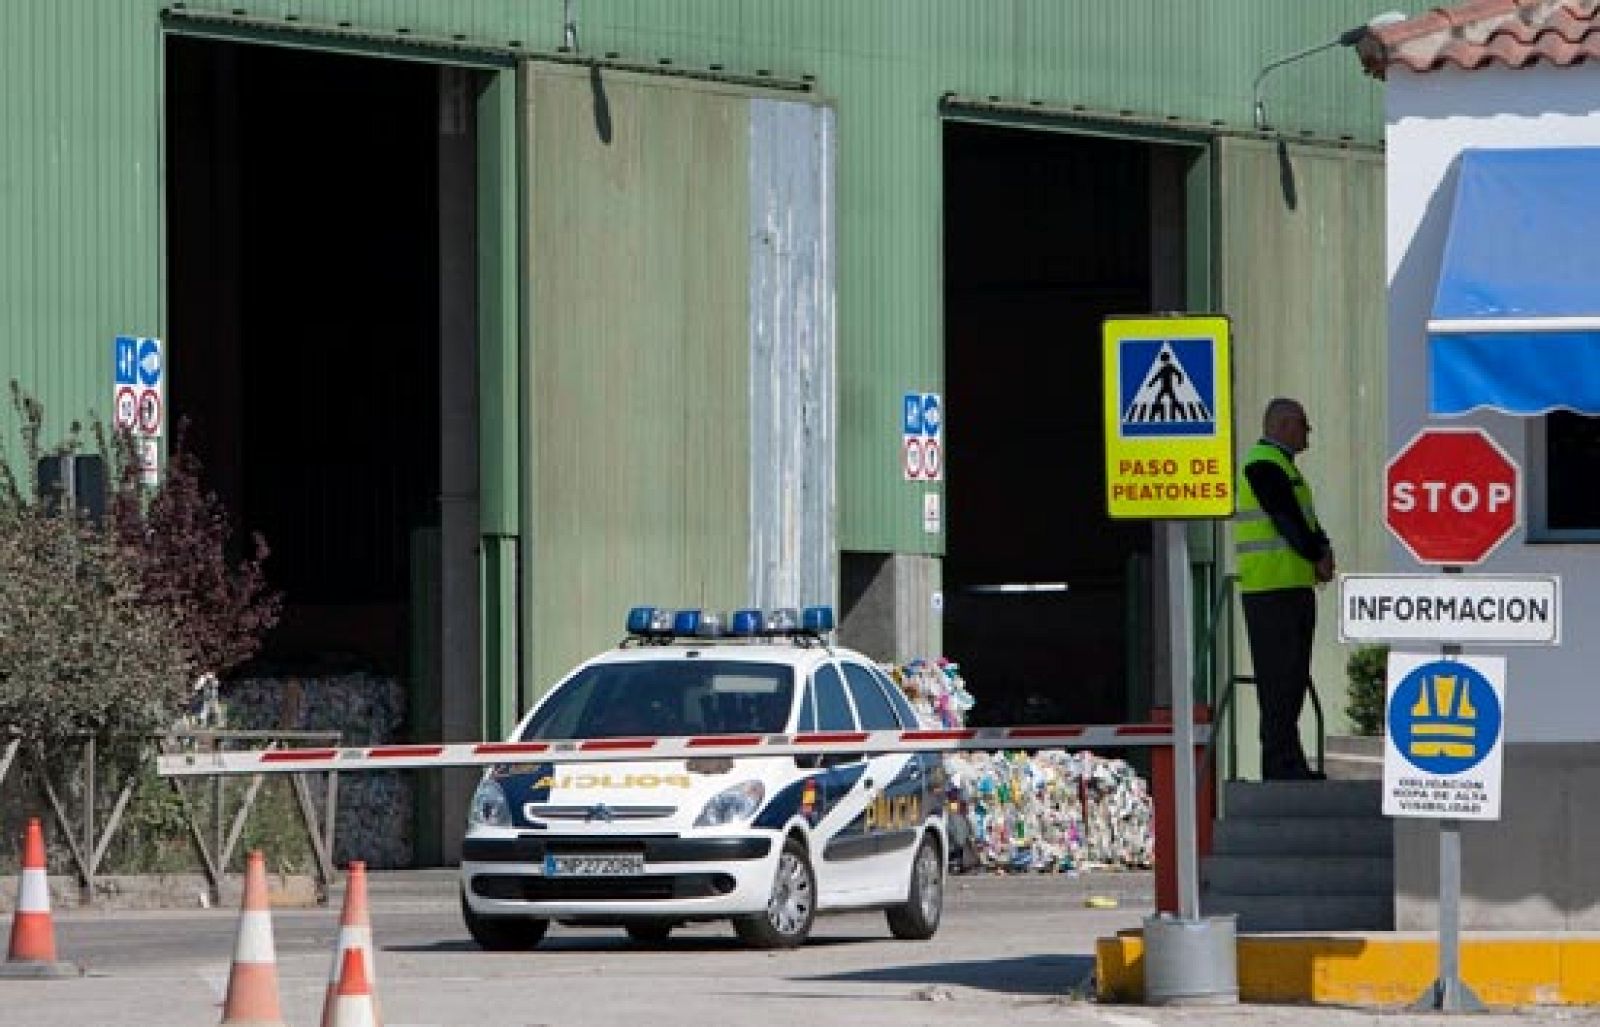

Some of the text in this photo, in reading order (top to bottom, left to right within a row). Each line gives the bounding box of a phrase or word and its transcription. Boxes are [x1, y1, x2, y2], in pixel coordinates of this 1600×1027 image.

[1119, 459, 1219, 476] PASO DE
[1112, 482, 1228, 501] PEATONES
[1392, 481, 1512, 513] STOP
[1349, 595, 1549, 622] INFORMACION
